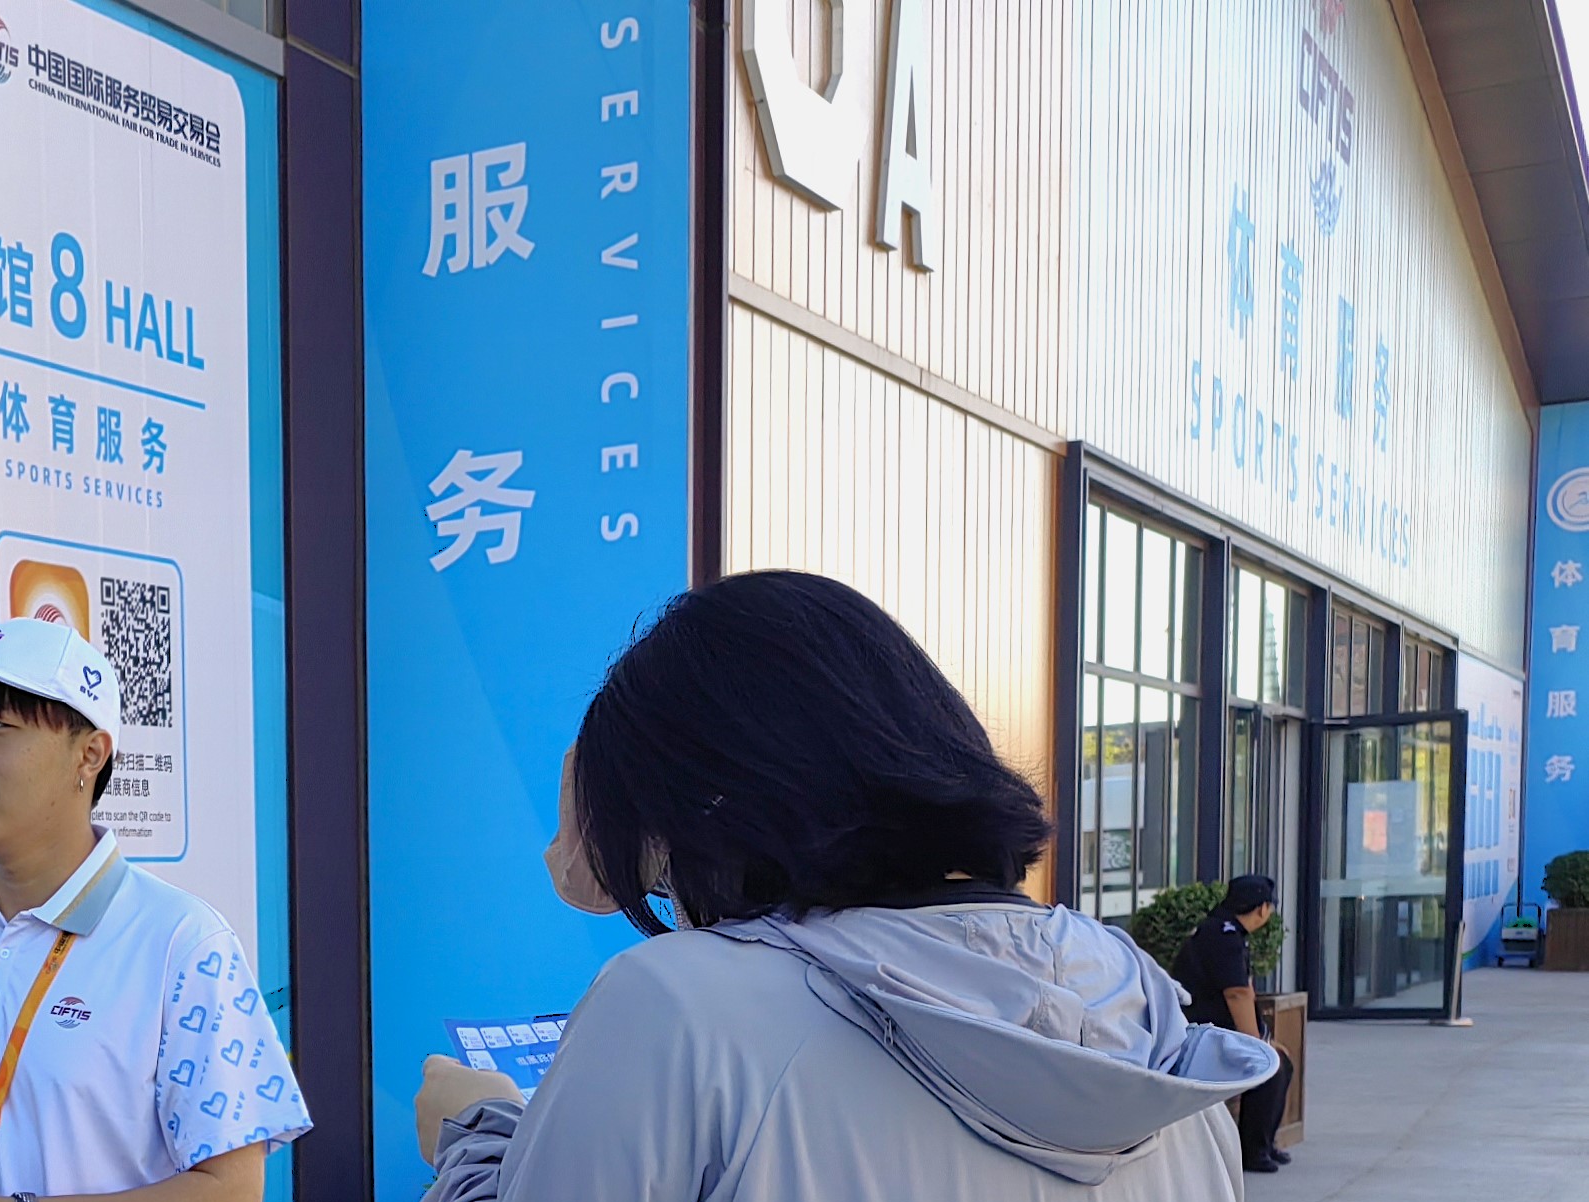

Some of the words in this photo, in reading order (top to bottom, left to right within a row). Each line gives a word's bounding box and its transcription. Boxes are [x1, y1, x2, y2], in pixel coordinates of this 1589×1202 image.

[28, 44, 221, 155] 中国国际服务贸易交易会
[28, 78, 57, 100] CHINA
[57, 89, 121, 127] INTERNATIONAL
[121, 117, 140, 133] FAIR
[138, 126, 155, 140] FOR
[155, 132, 179, 151] TRADE
[180, 142, 190, 155] IN
[189, 146, 222, 169] SERVICES
[1298, 29, 1356, 165] CIFTIS
[49, 231, 88, 341] 8
[104, 279, 206, 372] HALL
[600, 15, 640, 543] SERVICES
[4, 457, 74, 491] SPORTS
[82, 475, 164, 510] SERVICES
[1189, 359, 1300, 503] SPORTS
[1314, 452, 1411, 569] SERVICES
[1544, 559, 1584, 784] 体育服务
[113, 813, 128, 822] scan
[128, 811, 139, 822] the
[139, 811, 148, 823] QR
[149, 812, 164, 822] code
[172, 971, 186, 1003] BVF
[227, 952, 240, 982] BVF
[49, 1004, 93, 1021] CIFTIS
[211, 1002, 226, 1033] BVF
[249, 1038, 266, 1070] BVF
[232, 1090, 247, 1121] BVF
